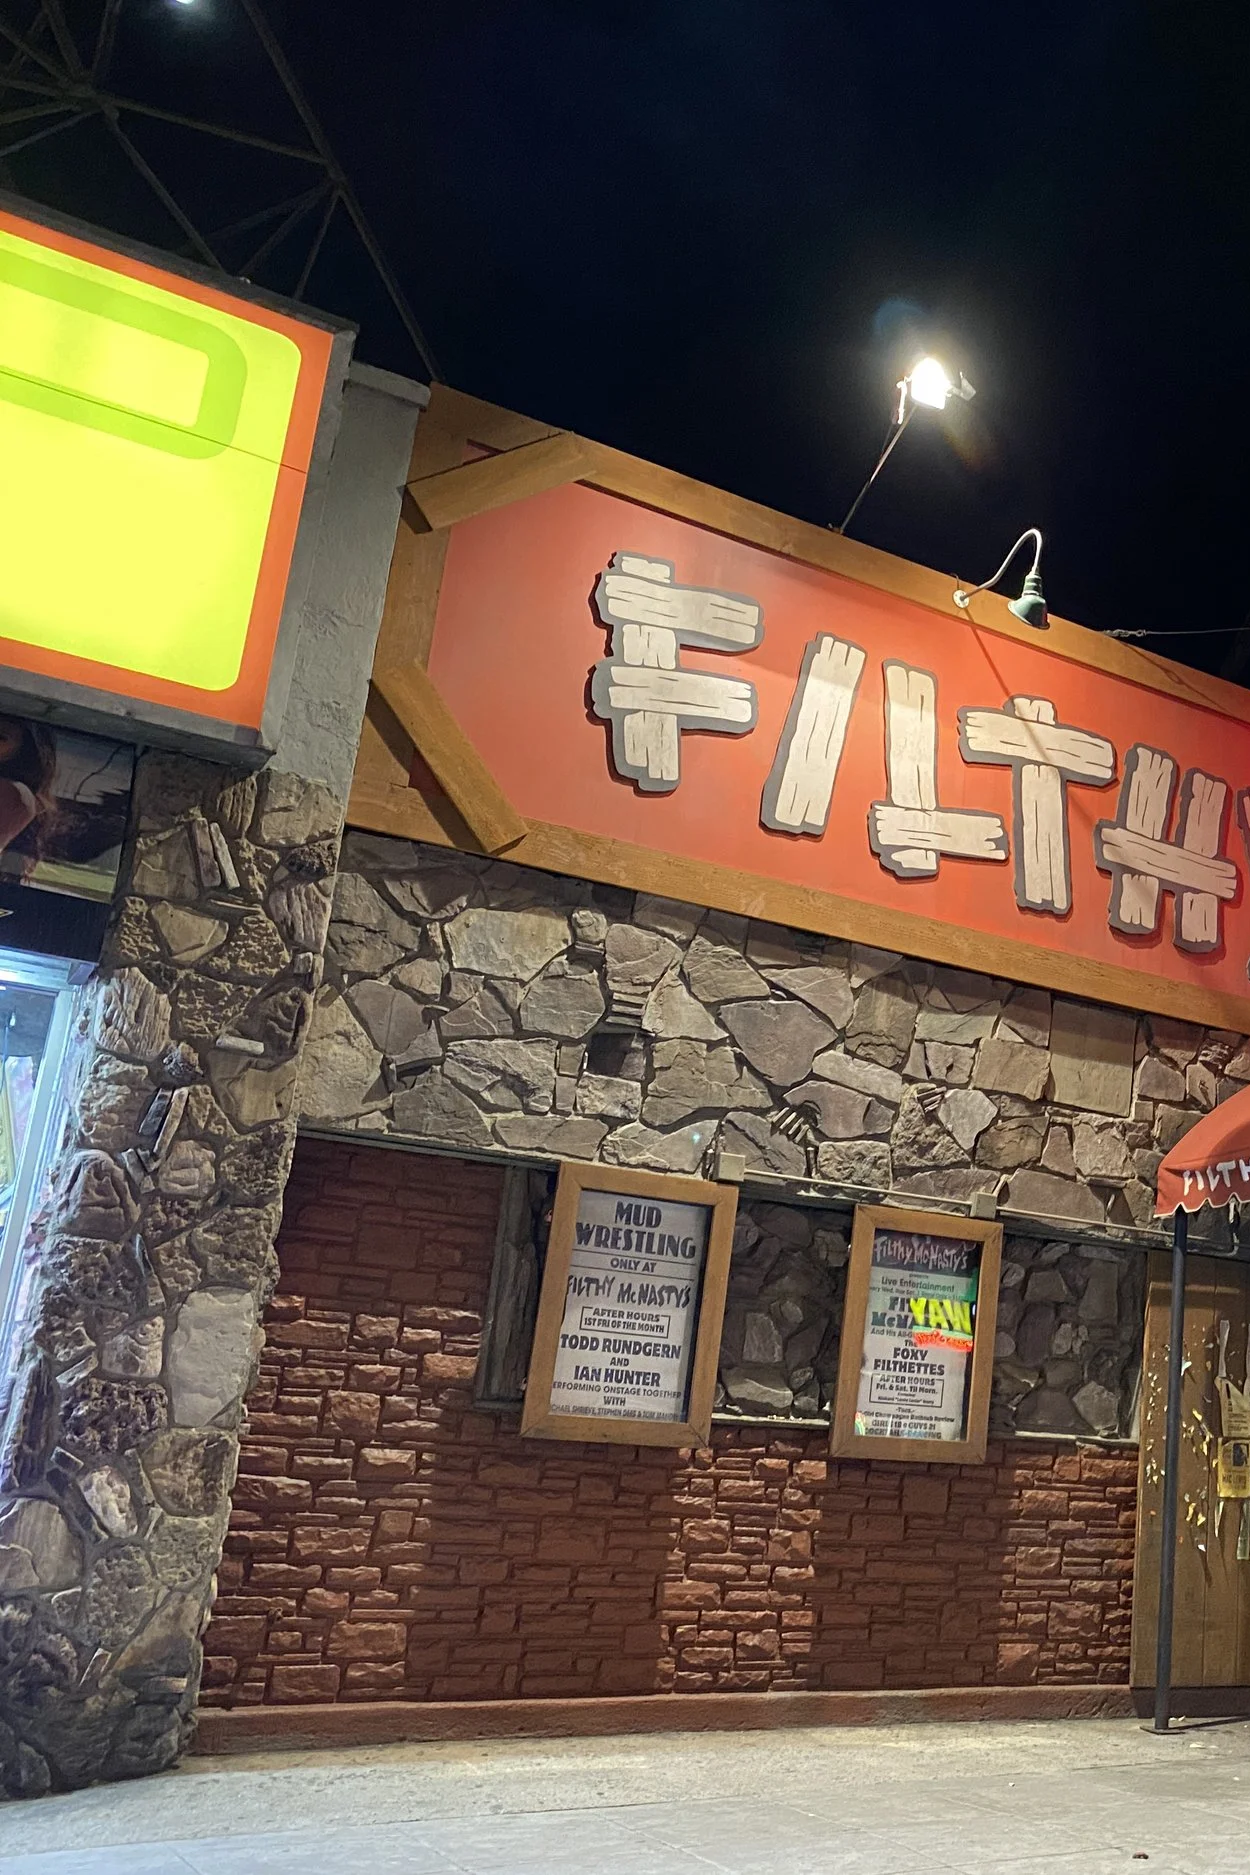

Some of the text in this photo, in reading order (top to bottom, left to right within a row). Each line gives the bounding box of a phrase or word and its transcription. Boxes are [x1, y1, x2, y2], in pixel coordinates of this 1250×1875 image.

[614, 1200, 662, 1229] MUD
[575, 1222, 697, 1260] WRESTLING
[610, 1257, 657, 1273] ONLY AT
[567, 1274, 616, 1298] FILTHY
[881, 1276, 955, 1293] Live Entertainment
[592, 1307, 660, 1323] AFTER HOURS
[584, 1317, 665, 1334] 1ST FRI OF THE MONTH
[870, 1327, 885, 1336] And
[886, 1328, 897, 1337] His
[560, 1333, 682, 1360] TODD RUNDGERN
[892, 1347, 929, 1361] FOXY
[609, 1357, 630, 1367] AND
[873, 1358, 945, 1376] FILTHETTES
[573, 1365, 661, 1388] IAN HUNTER
[879, 1374, 936, 1386] AFTER HOURS
[552, 1381, 601, 1393] ERFORMING
[603, 1385, 641, 1396] ONSTAGE
[603, 1396, 627, 1407] WITH
